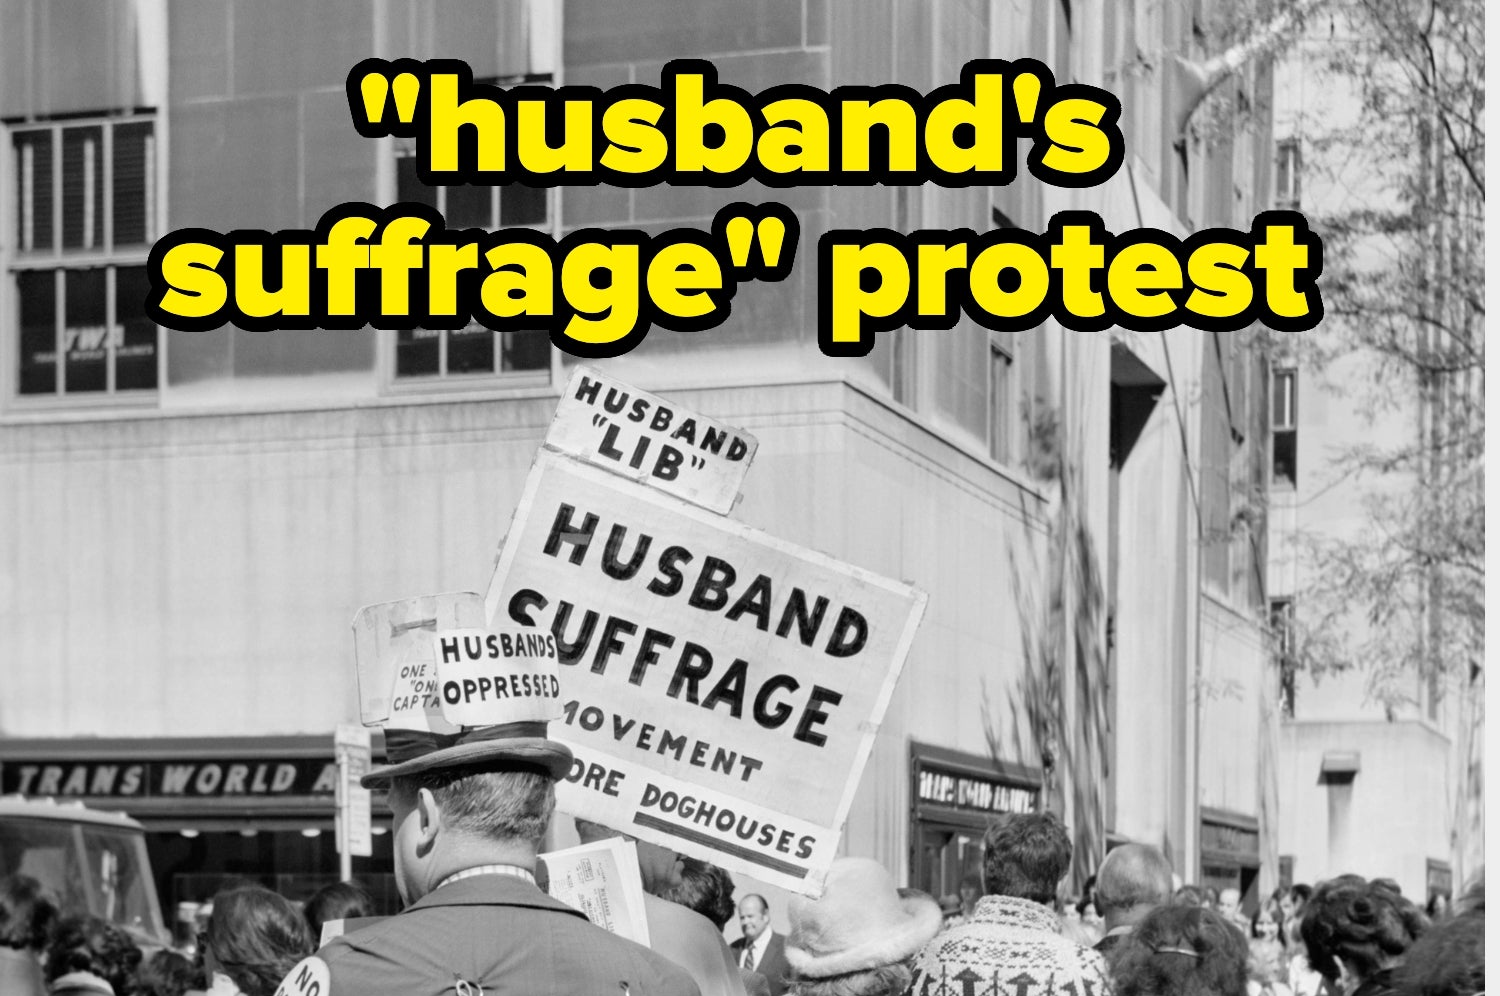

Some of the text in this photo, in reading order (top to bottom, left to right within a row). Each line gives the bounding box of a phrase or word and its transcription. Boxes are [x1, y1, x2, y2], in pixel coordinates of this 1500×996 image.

[575, 376, 747, 461] HUSBAND
[592, 413, 706, 482] "LIB"
[543, 502, 868, 657] HUSBAND
[401, 664, 427, 679] ONE
[440, 633, 556, 663] HUSBANDS
[508, 590, 843, 748] SUFFRAGE
[443, 674, 560, 705] OPPRESSED
[18, 765, 143, 794] TRANS
[161, 763, 297, 793] WORLD
[566, 758, 816, 860] ORE DOGHOUSES
